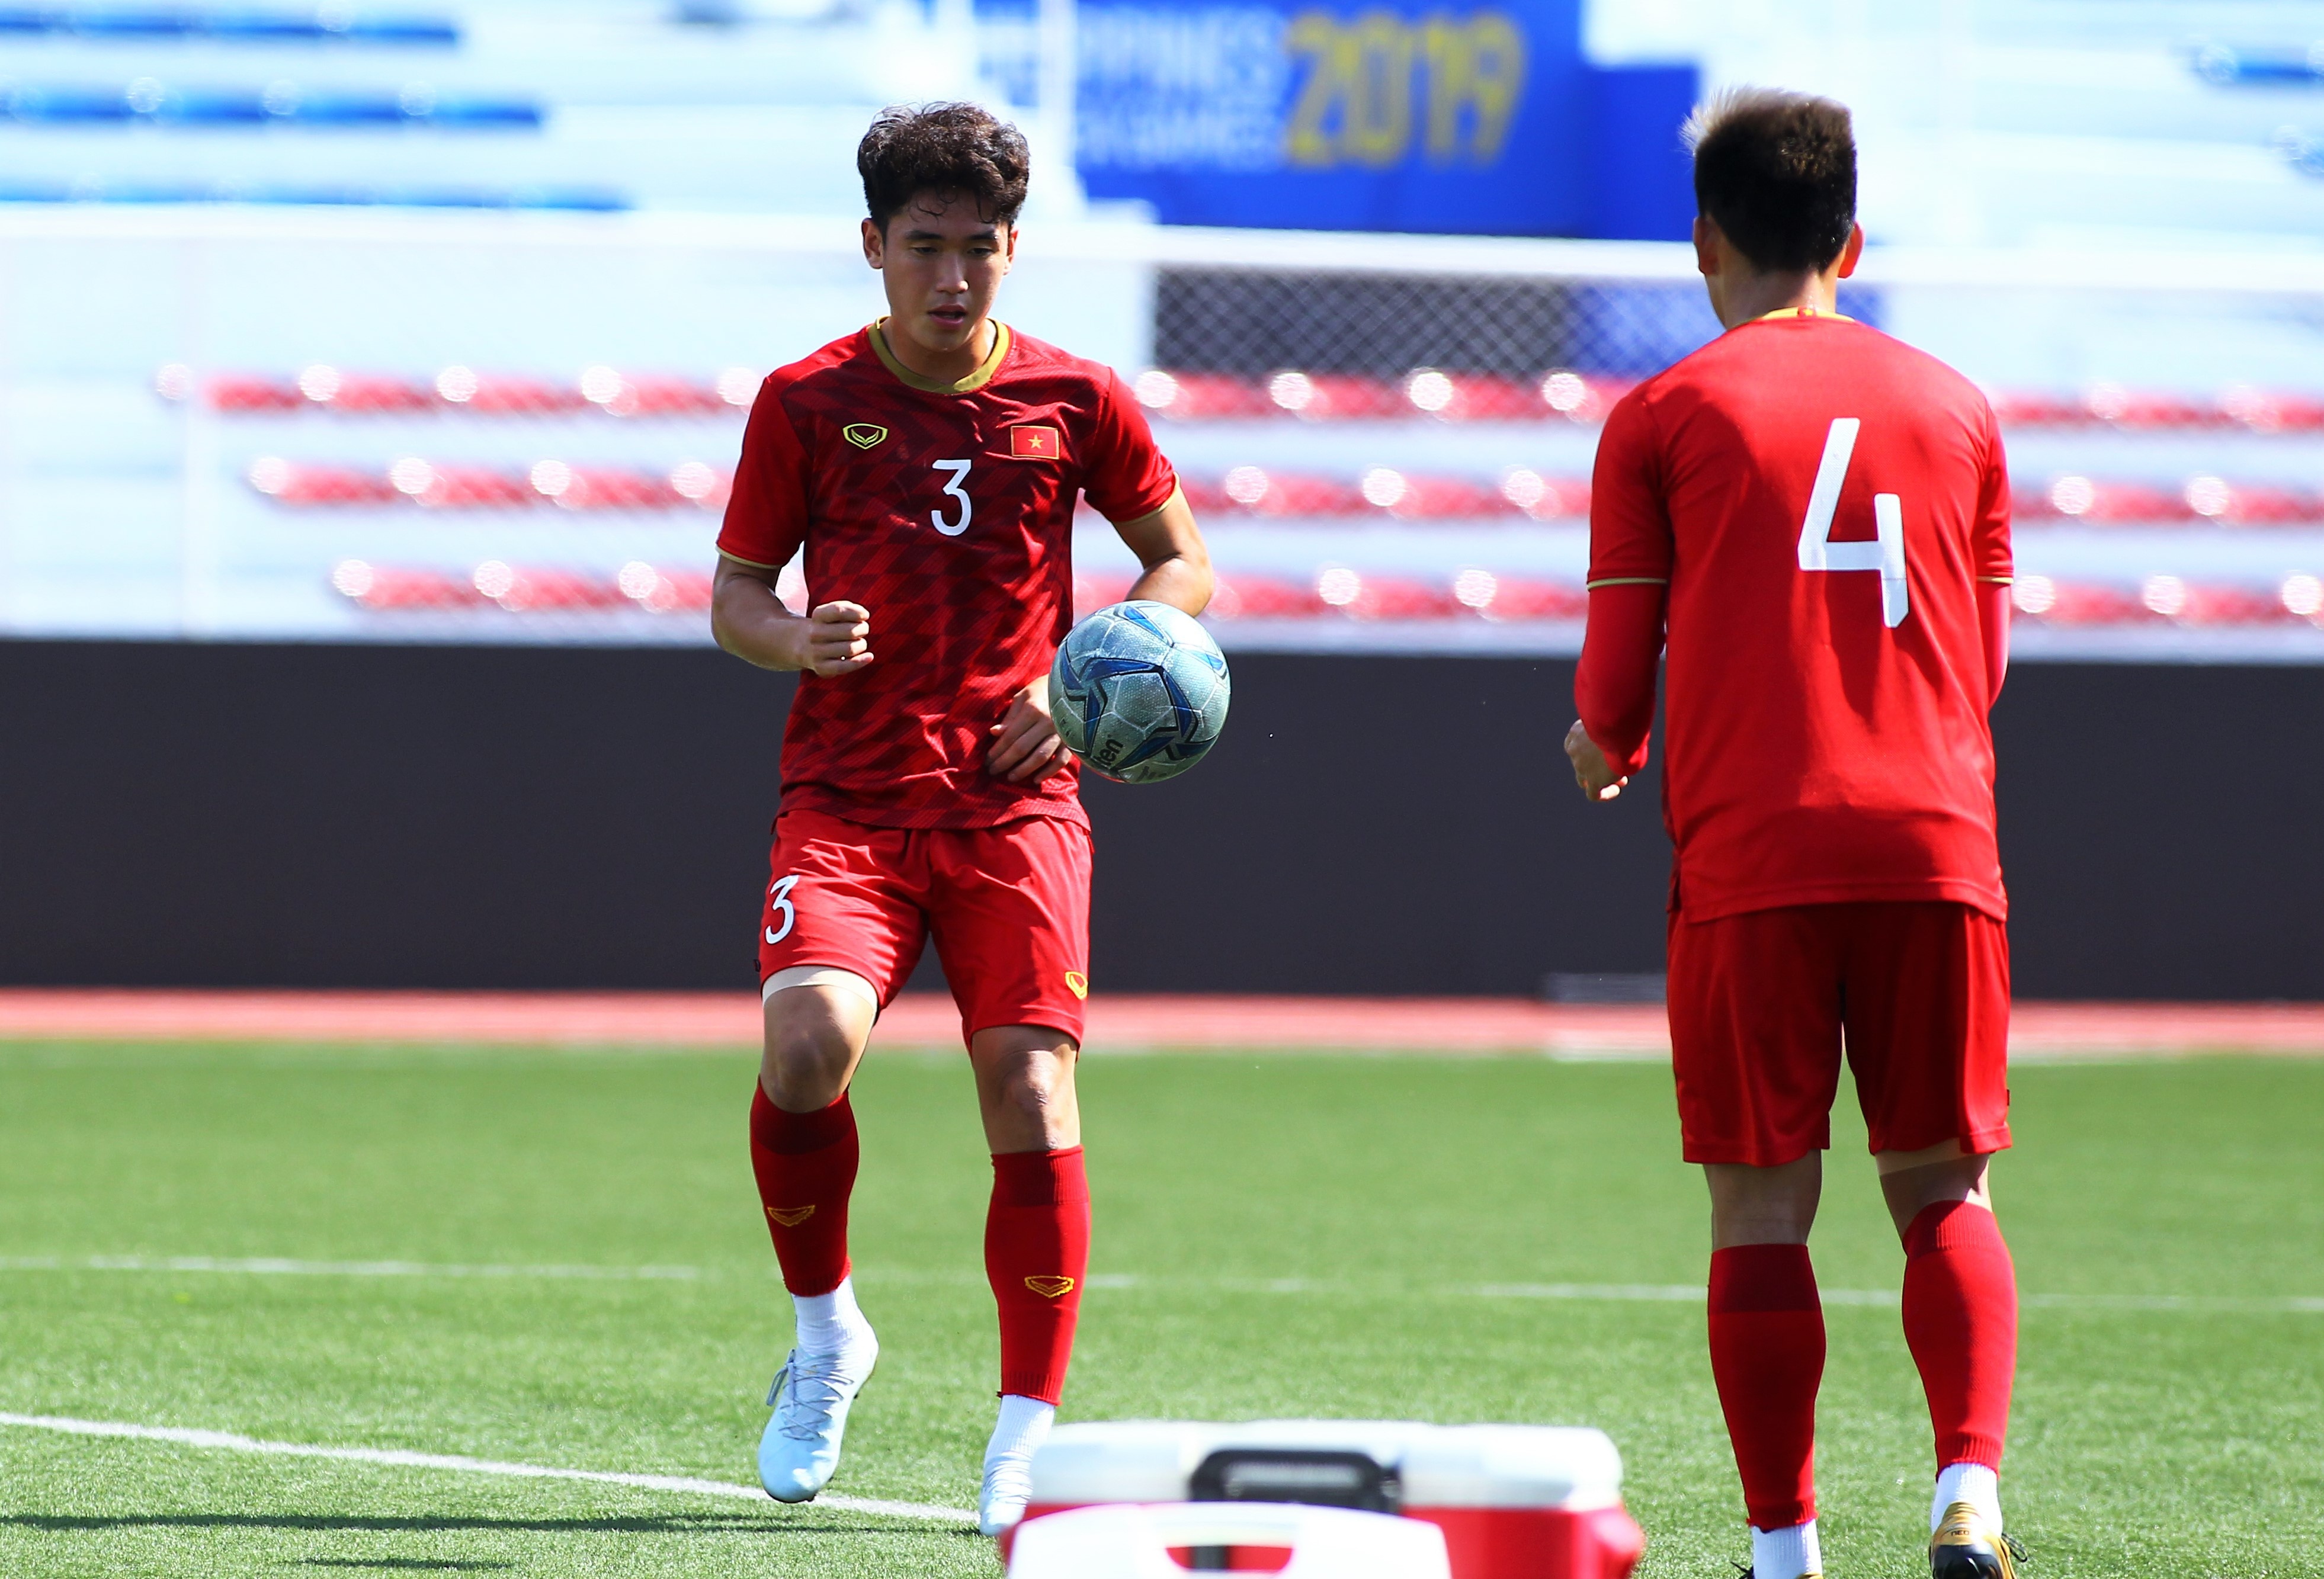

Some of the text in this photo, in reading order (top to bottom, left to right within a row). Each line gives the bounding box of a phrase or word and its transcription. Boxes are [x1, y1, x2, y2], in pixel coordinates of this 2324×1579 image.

[1283, 13, 1527, 169] 2019
[931, 460, 972, 535] 3
[1797, 418, 1909, 628] 4
[765, 874, 799, 944] 3
